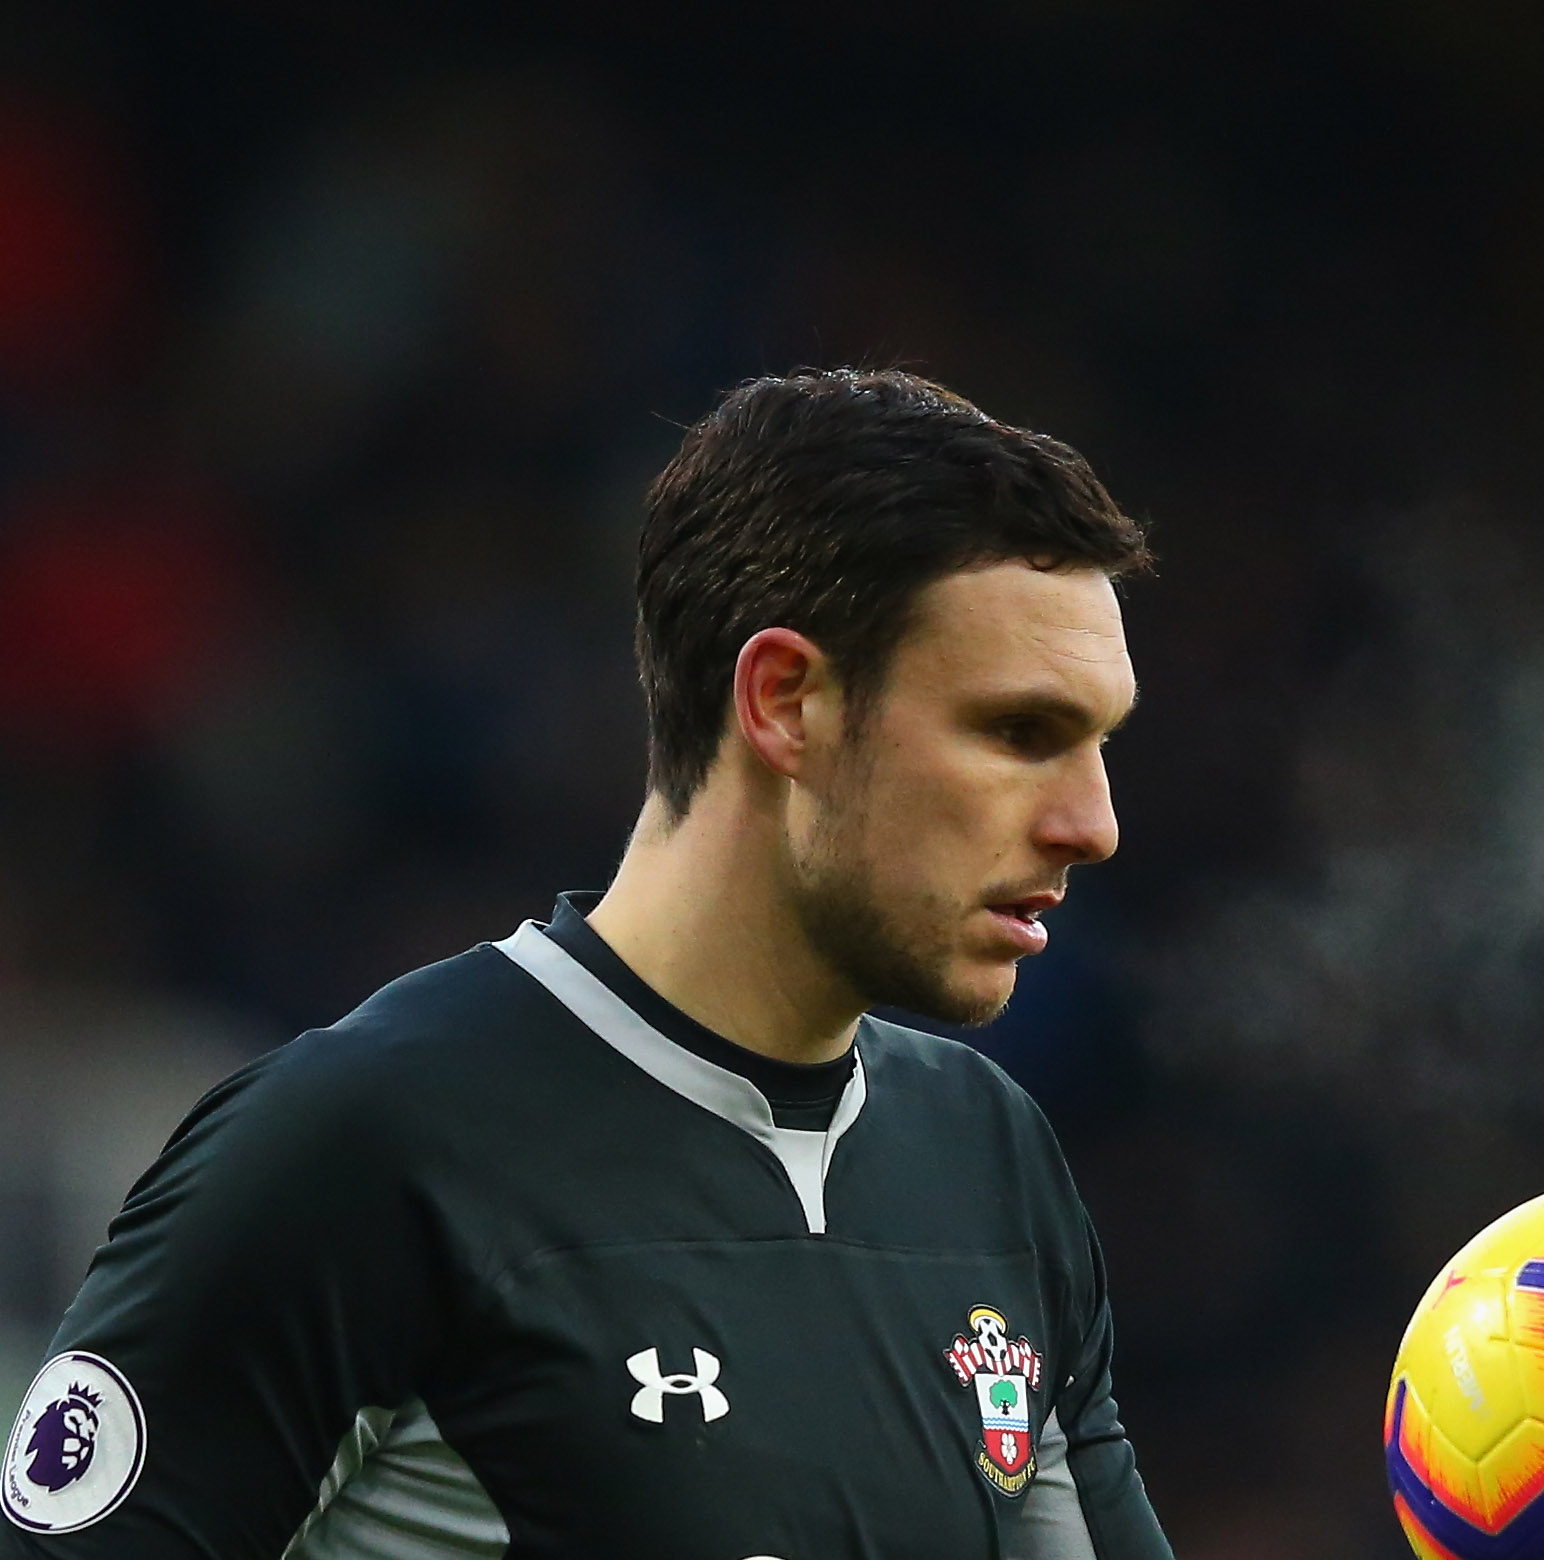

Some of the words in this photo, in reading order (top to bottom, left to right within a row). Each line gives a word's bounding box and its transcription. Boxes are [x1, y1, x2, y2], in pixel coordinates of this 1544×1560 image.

[10, 1408, 32, 1462] Premier
[8, 1464, 30, 1507] League
[978, 1451, 1027, 1492] SOUTHAMPTON
[1026, 1456, 1036, 1479] FC
